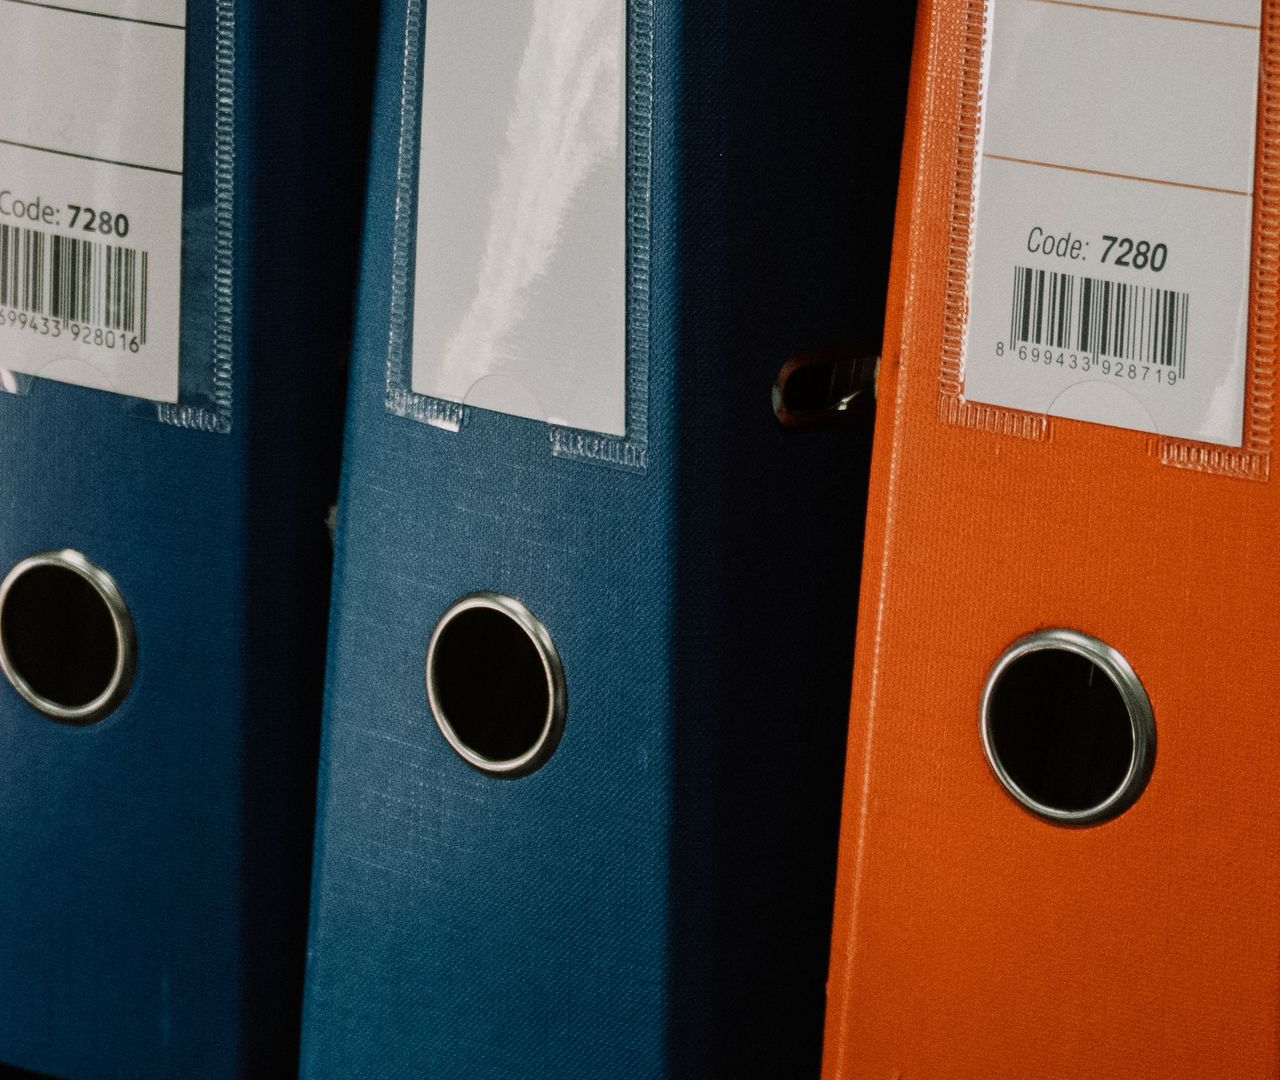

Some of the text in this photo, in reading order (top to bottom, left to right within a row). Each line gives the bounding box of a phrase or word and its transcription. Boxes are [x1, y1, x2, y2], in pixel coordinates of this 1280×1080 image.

[67, 204, 130, 238] 7280
[1027, 226, 1169, 272] Code: 7280
[70, 323, 140, 353] 928016
[995, 341, 1178, 386] 8 699433 928719
